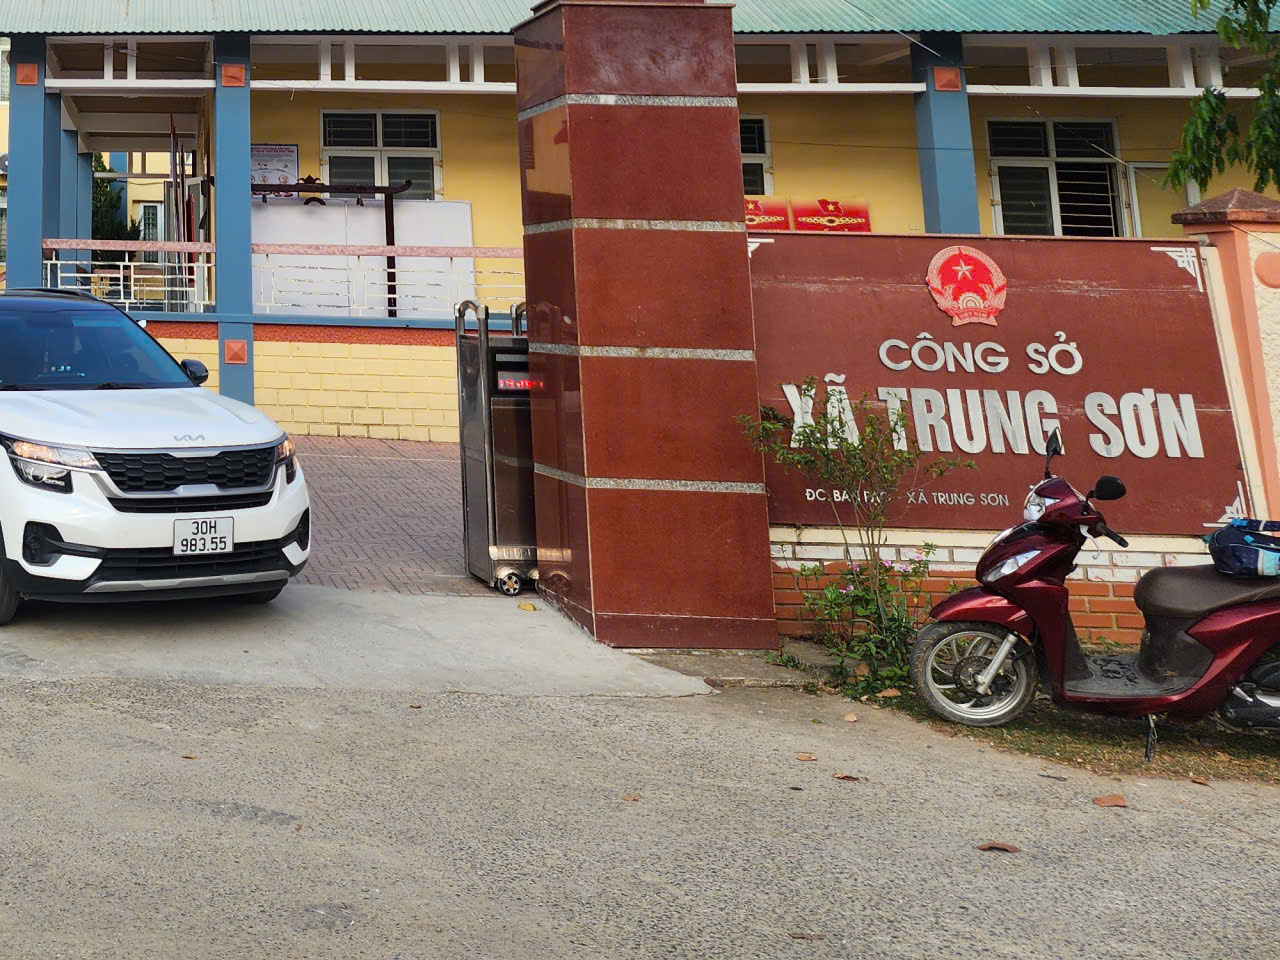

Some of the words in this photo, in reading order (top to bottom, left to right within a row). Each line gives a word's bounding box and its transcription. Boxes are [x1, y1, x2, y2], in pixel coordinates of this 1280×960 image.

[878, 331, 1010, 374] CÔNG
[1026, 330, 1083, 375] SỞ
[782, 372, 860, 450] XÃ
[877, 386, 1066, 457] TRUNG
[1084, 387, 1206, 459] SƠN
[907, 488, 928, 505] XÃ
[931, 491, 976, 506] TRUNG
[980, 492, 1010, 507] SƠN
[192, 520, 217, 535] 30H
[180, 536, 227, 552] 983.55
